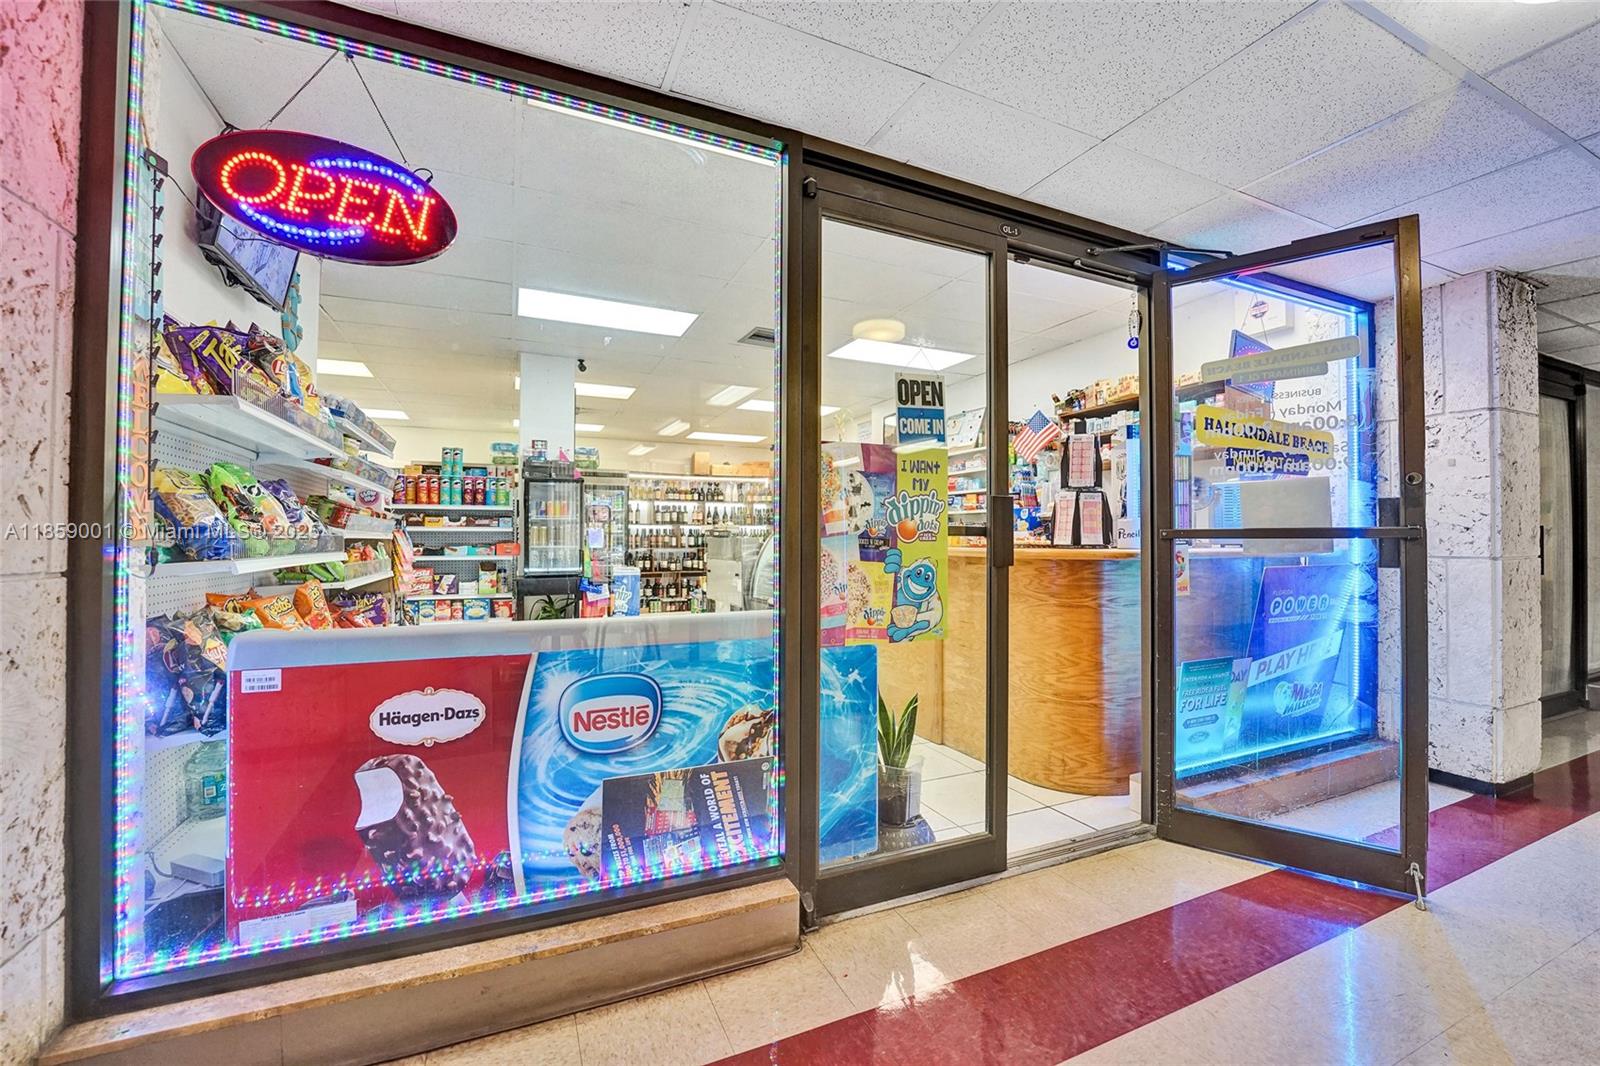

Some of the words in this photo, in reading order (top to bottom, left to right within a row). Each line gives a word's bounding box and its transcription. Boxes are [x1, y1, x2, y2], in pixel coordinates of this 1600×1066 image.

[220, 151, 436, 241] OPEN
[897, 378, 944, 407] OPEN
[899, 417, 932, 435] COME
[932, 418, 945, 435] IN
[901, 459, 907, 473] I
[912, 477, 930, 491] MY
[1255, 650, 1297, 680] PLAY
[1180, 697, 1203, 713] FOR
[1204, 691, 1228, 709] LIFE
[699, 773, 710, 786] OF
[704, 788, 720, 821] WORLD
[712, 822, 723, 830] A
[607, 833, 618, 850] FROM
[715, 830, 730, 861] EVEAL
